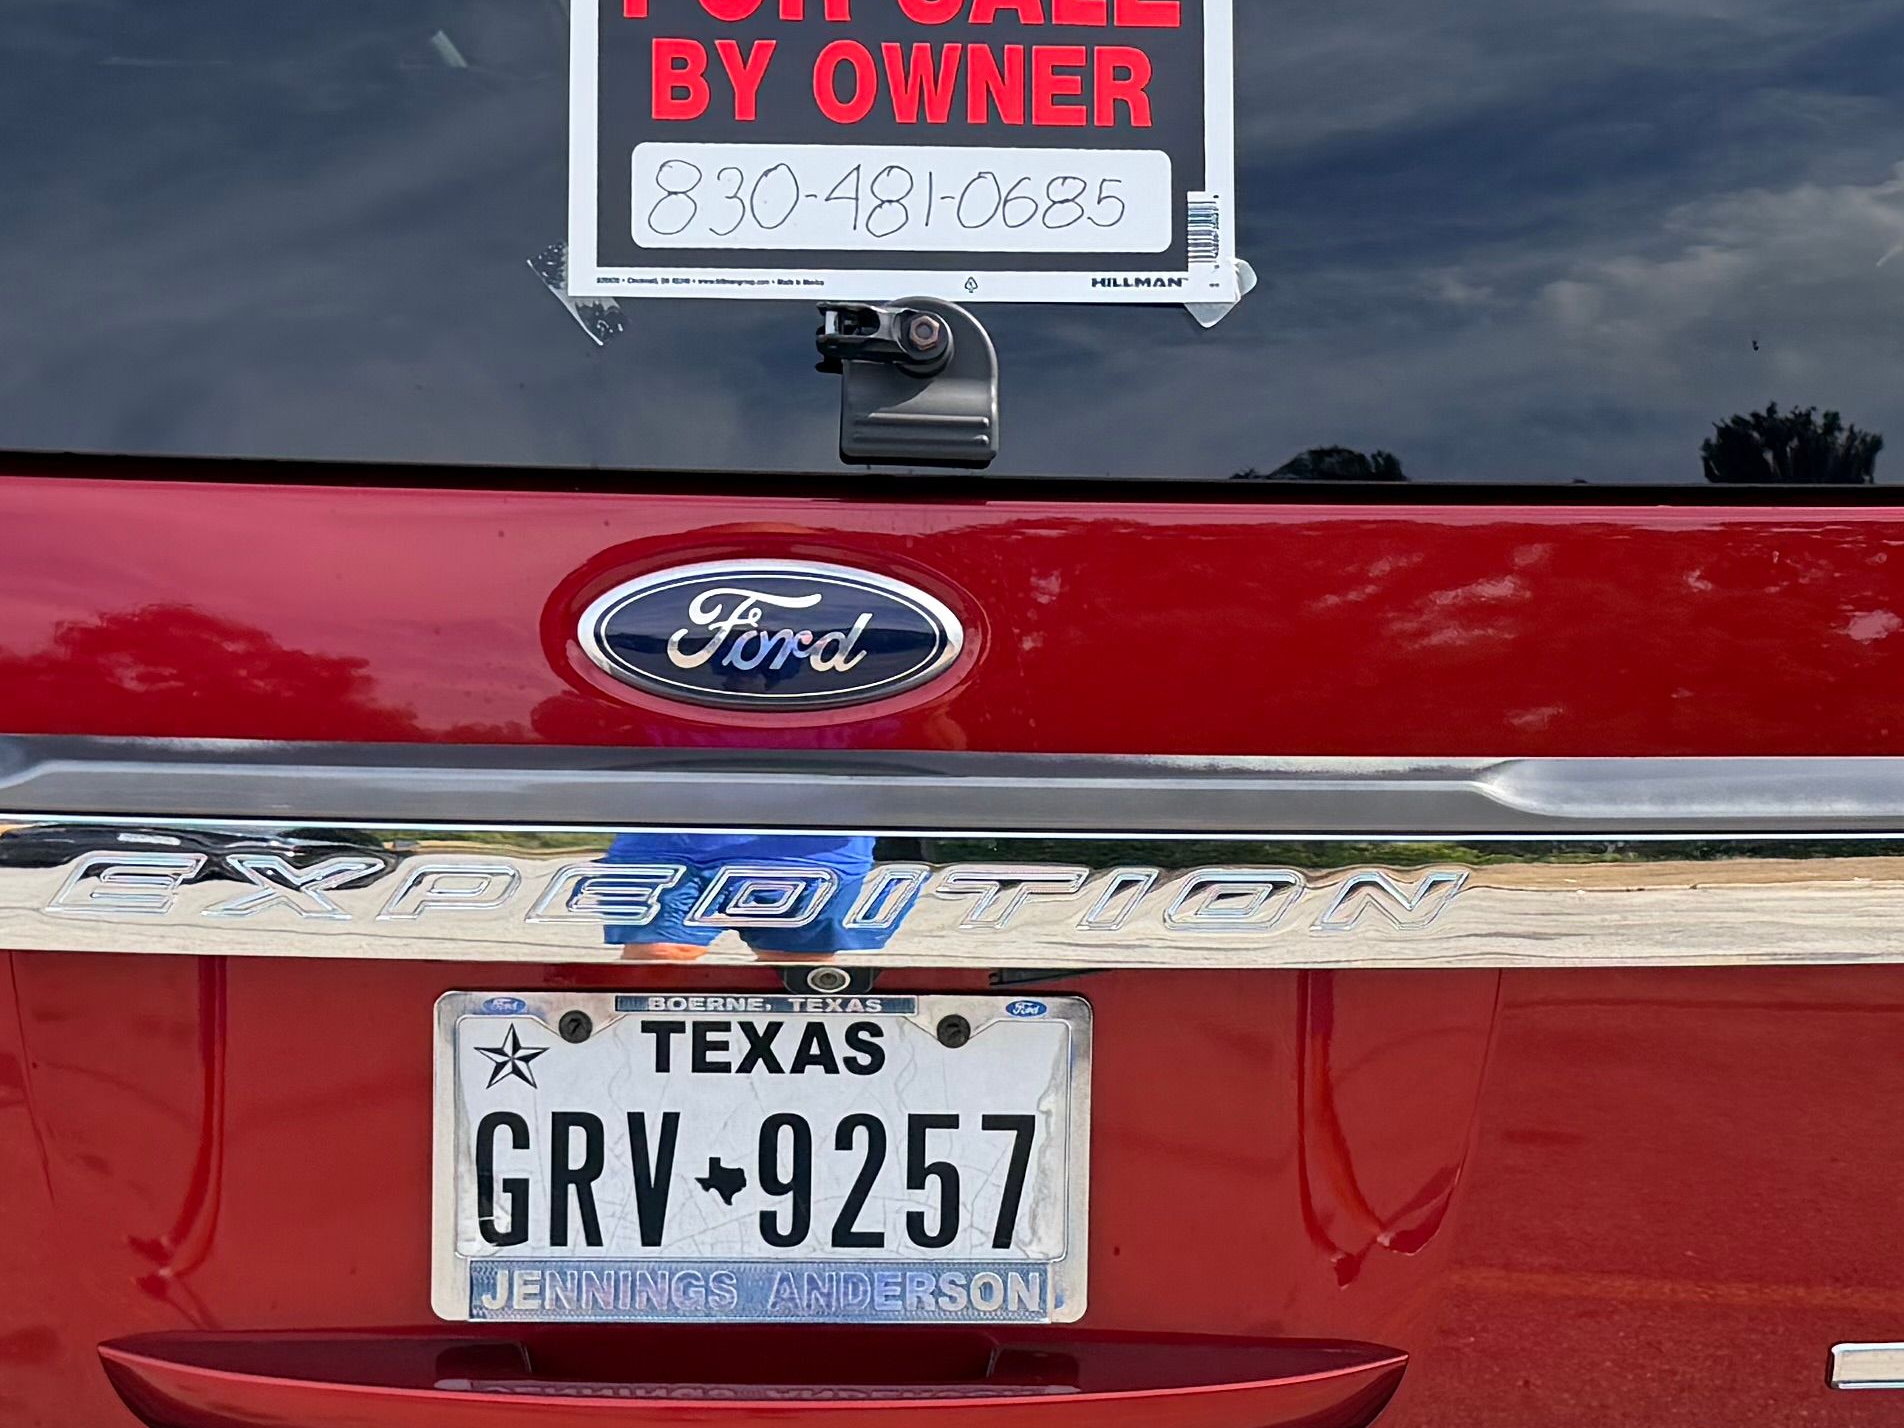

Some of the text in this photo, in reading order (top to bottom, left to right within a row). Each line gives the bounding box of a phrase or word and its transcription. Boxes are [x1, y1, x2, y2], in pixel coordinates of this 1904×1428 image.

[651, 36, 1155, 128] BY OWNER
[646, 159, 1127, 238] 830-481-0685
[1091, 277, 1182, 287] HILLMAN
[667, 587, 873, 673] Ford
[43, 851, 1471, 932] EXPEDITION
[647, 996, 883, 1014] BOERNE, TEXAS
[641, 1020, 886, 1076] TEXAS
[476, 1110, 1036, 1250] GRV 9257
[481, 1269, 1041, 1312] JENNINGS ANDERSON
